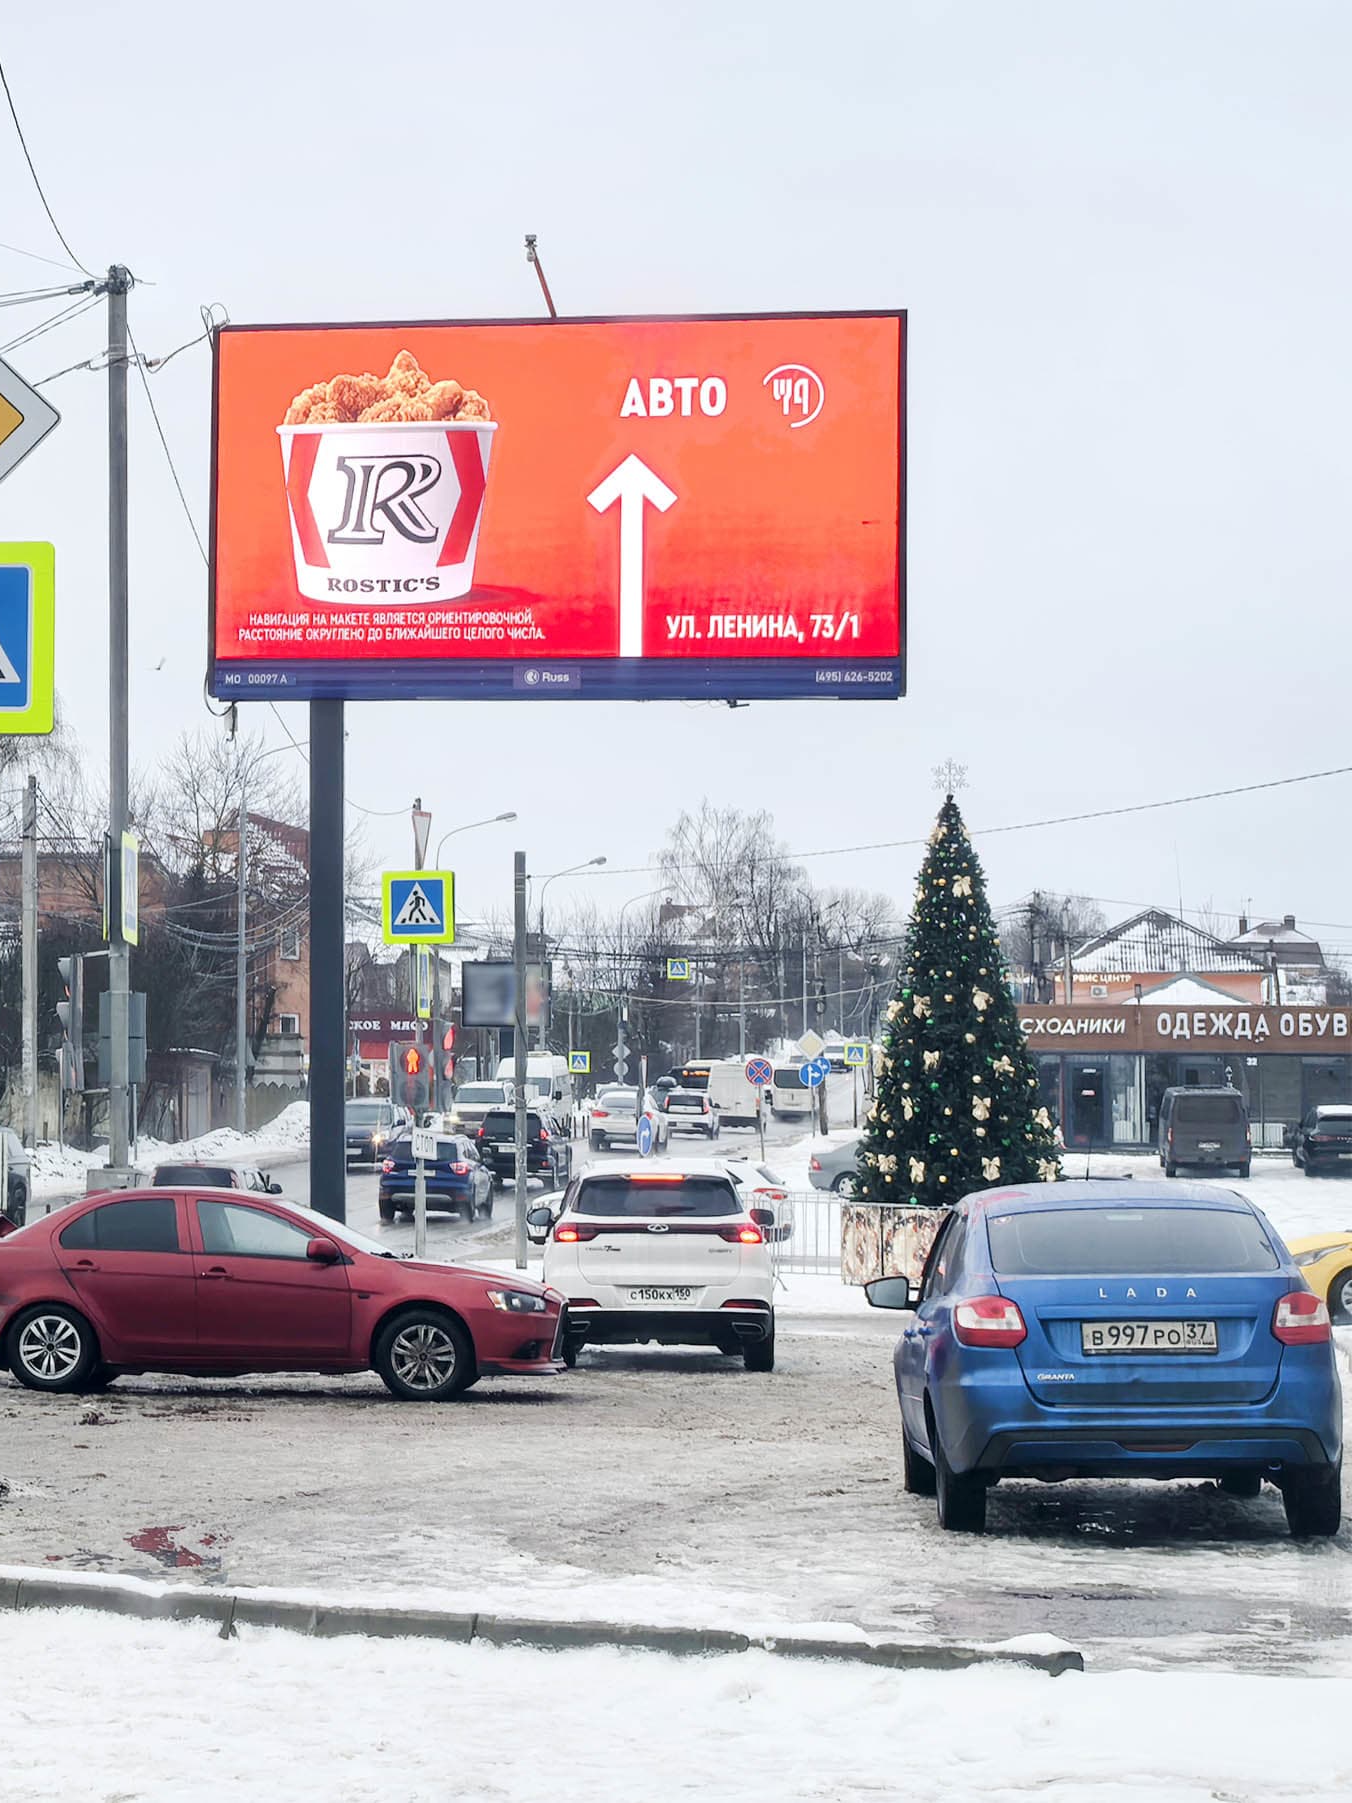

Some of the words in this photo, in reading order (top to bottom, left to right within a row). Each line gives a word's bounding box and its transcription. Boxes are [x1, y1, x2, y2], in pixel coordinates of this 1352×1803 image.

[619, 377, 727, 418] АВТО
[327, 576, 440, 593] ROSTIC'S
[249, 613, 309, 627] НАВИГАЦИЯ
[312, 613, 328, 626] НА
[330, 612, 370, 626] МАКЕТЕ
[372, 611, 425, 625] ЯВЛЯЕТСЯ
[427, 608, 535, 626] ОРИЕНТИРОВОЧНОЙ,
[238, 628, 303, 641] РАССТОЯНИЕ
[305, 627, 365, 641] ОКРУГЛЕНО
[367, 627, 383, 642] ДО
[385, 624, 461, 641] БЛИЖАЙШЕГО
[463, 626, 505, 641] ЦЕЛОГО
[507, 625, 546, 639] ЧИСЛА.
[666, 614, 701, 639] УЛ.
[707, 614, 804, 643] ЛЕНИНА,
[810, 611, 859, 641] 73/1
[248, 674, 277, 685] 00097
[542, 671, 569, 683] Russ
[815, 670, 842, 683] (495)
[844, 670, 893, 683] 626-5202
[1019, 1017, 1126, 1035] СХОДНИКИ
[1156, 1012, 1271, 1040] ОДЕЖДА
[416, 1134, 434, 1153] СТОП
[1098, 1287, 1197, 1298] LADA
[1186, 1323, 1207, 1340] 37
